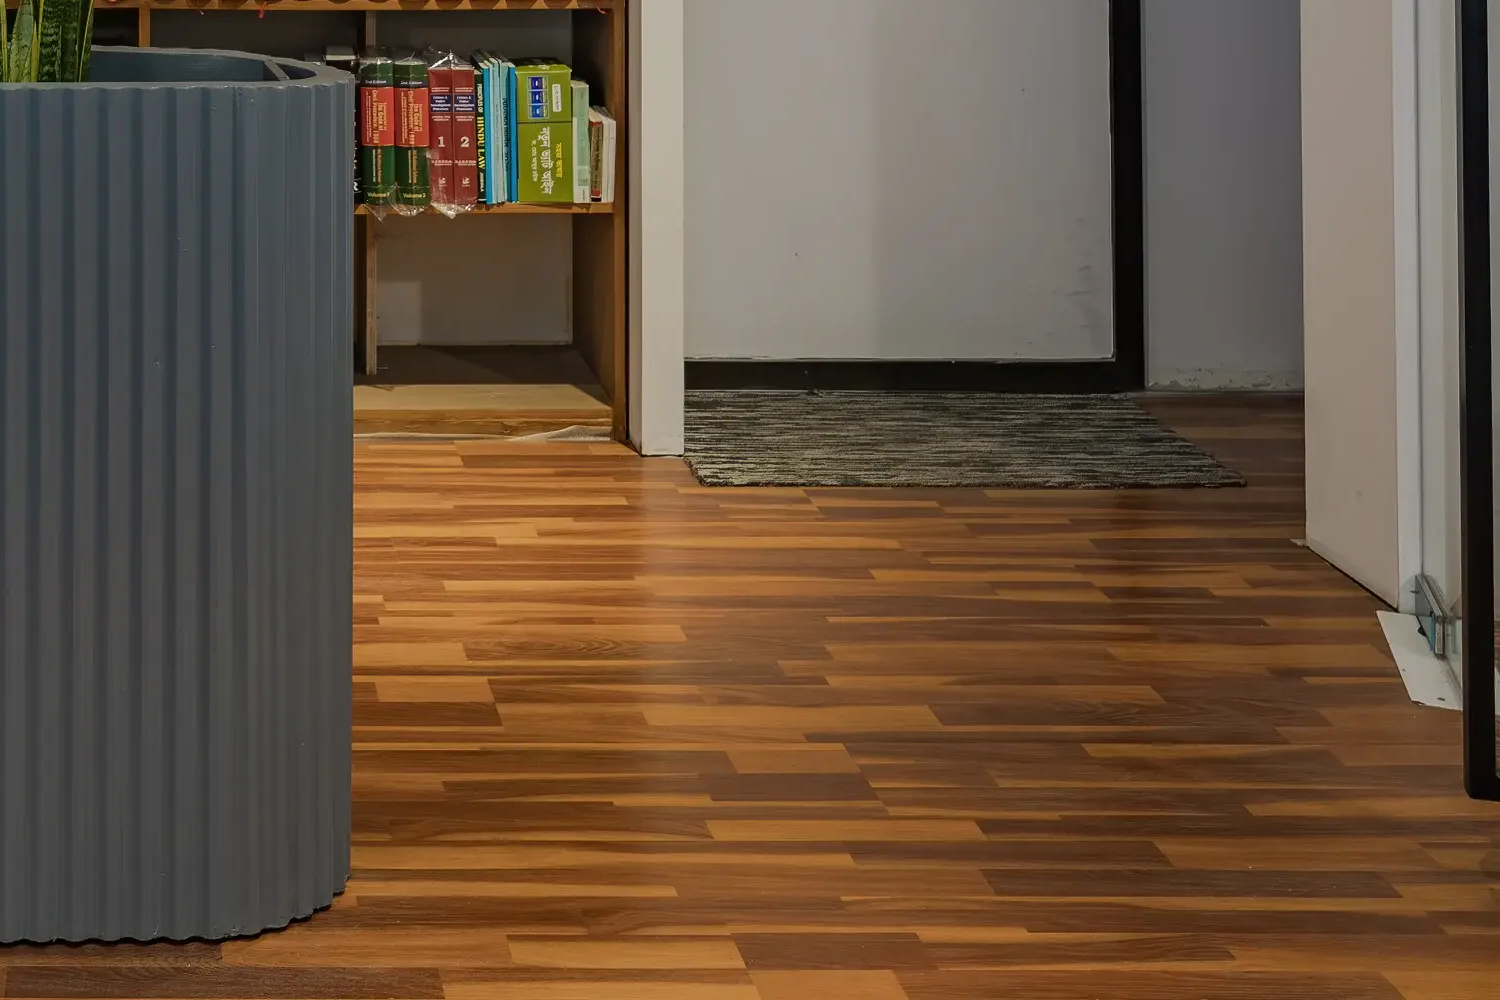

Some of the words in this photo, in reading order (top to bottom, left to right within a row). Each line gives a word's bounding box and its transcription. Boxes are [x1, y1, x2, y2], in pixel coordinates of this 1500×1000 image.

[476, 117, 485, 146] HINDU
[537, 127, 550, 148] নতুন
[438, 136, 445, 148] 1
[460, 136, 470, 148] 2
[541, 149, 554, 169] ভ্যাট
[541, 170, 554, 194] আইন
